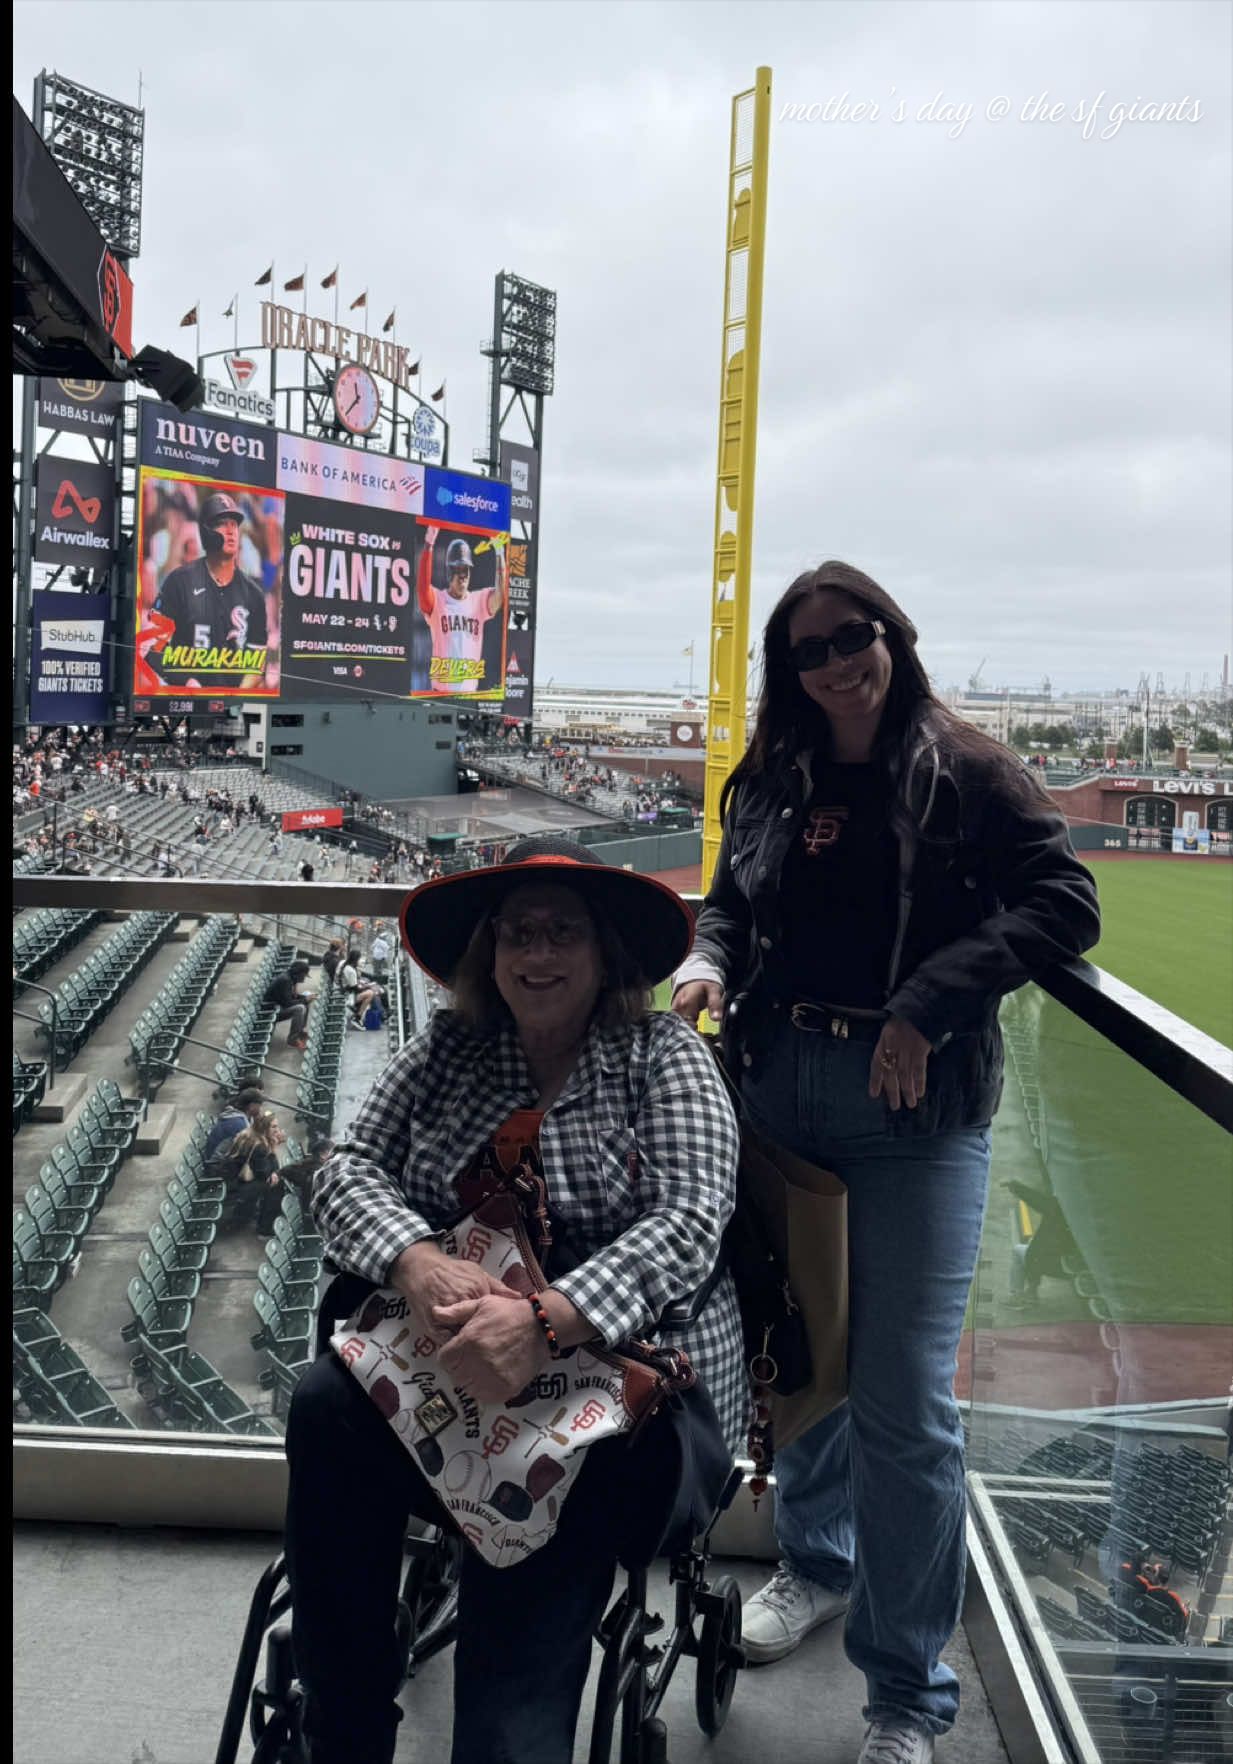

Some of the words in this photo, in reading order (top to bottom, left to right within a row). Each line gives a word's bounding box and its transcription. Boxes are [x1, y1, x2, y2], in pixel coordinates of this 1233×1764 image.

[261, 302, 351, 361] ORACLE
[356, 332, 411, 389] PARK
[207, 383, 274, 417] Fanatics
[43, 400, 89, 422] HABBAS
[91, 410, 115, 427] LAW
[156, 417, 265, 460] nuveen
[155, 445, 162, 455] A
[163, 446, 185, 460] TIAA
[185, 450, 220, 467] Company
[280, 456, 319, 476] BANK
[322, 464, 339, 480] OF
[341, 469, 398, 492] AMERICA
[453, 491, 499, 512] salesforce
[511, 495, 533, 510] ealth
[40, 525, 110, 550] Airwallex
[302, 523, 356, 545] WHITE
[358, 533, 390, 550] SOX
[289, 544, 410, 606] GIANTS
[302, 612, 328, 625] MAY
[330, 614, 345, 627] 22
[354, 617, 370, 629] 24
[440, 614, 480, 636] GIANTS
[48, 628, 96, 642] StubHub
[194, 623, 211, 649] 5
[162, 645, 267, 669] MURAKAMI
[293, 639, 406, 656] SFGIANTS.COM/TICKETS
[41, 660, 64, 675] 100%
[65, 661, 101, 676] VERIFIED
[38, 677, 68, 692] GIANTS
[70, 678, 104, 693] TICKETS
